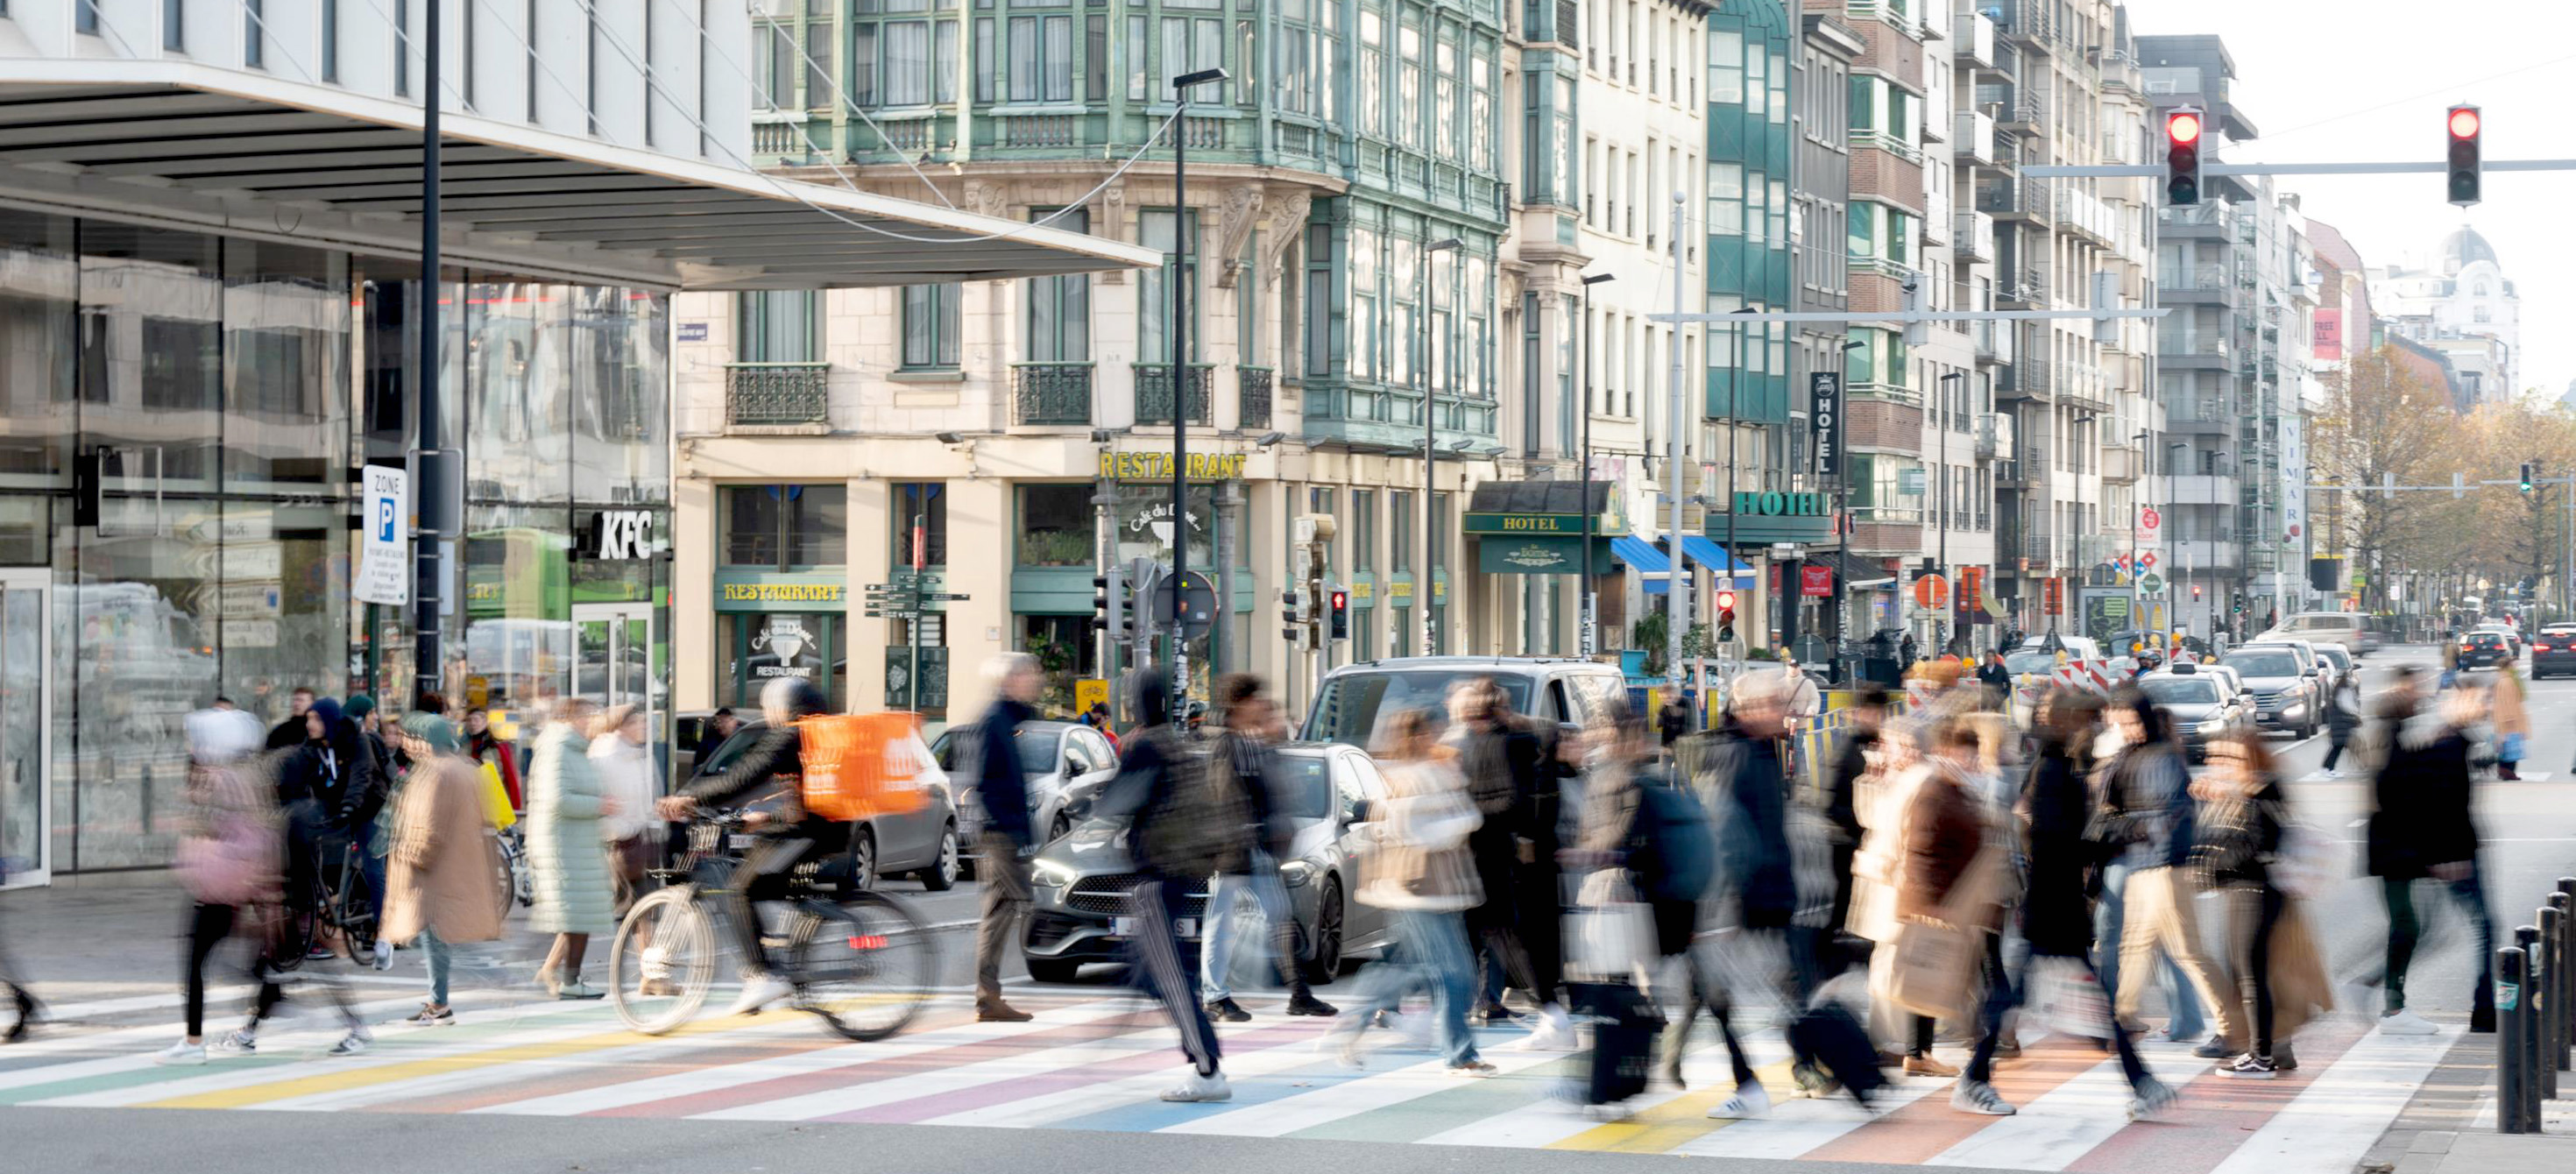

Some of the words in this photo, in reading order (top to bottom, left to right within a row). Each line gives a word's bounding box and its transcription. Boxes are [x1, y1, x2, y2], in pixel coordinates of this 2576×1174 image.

[1817, 398, 1831, 472] HOTEL
[375, 474, 400, 495] ZONE
[2287, 426, 2297, 520] VIMAR
[1734, 491, 1819, 516] HOTEL
[380, 501, 393, 538] P
[1504, 517, 1560, 531] HOTEL
[599, 510, 653, 561] KFC
[724, 583, 841, 602] RESTAURANT
[756, 666, 811, 677] RESTAURANT
